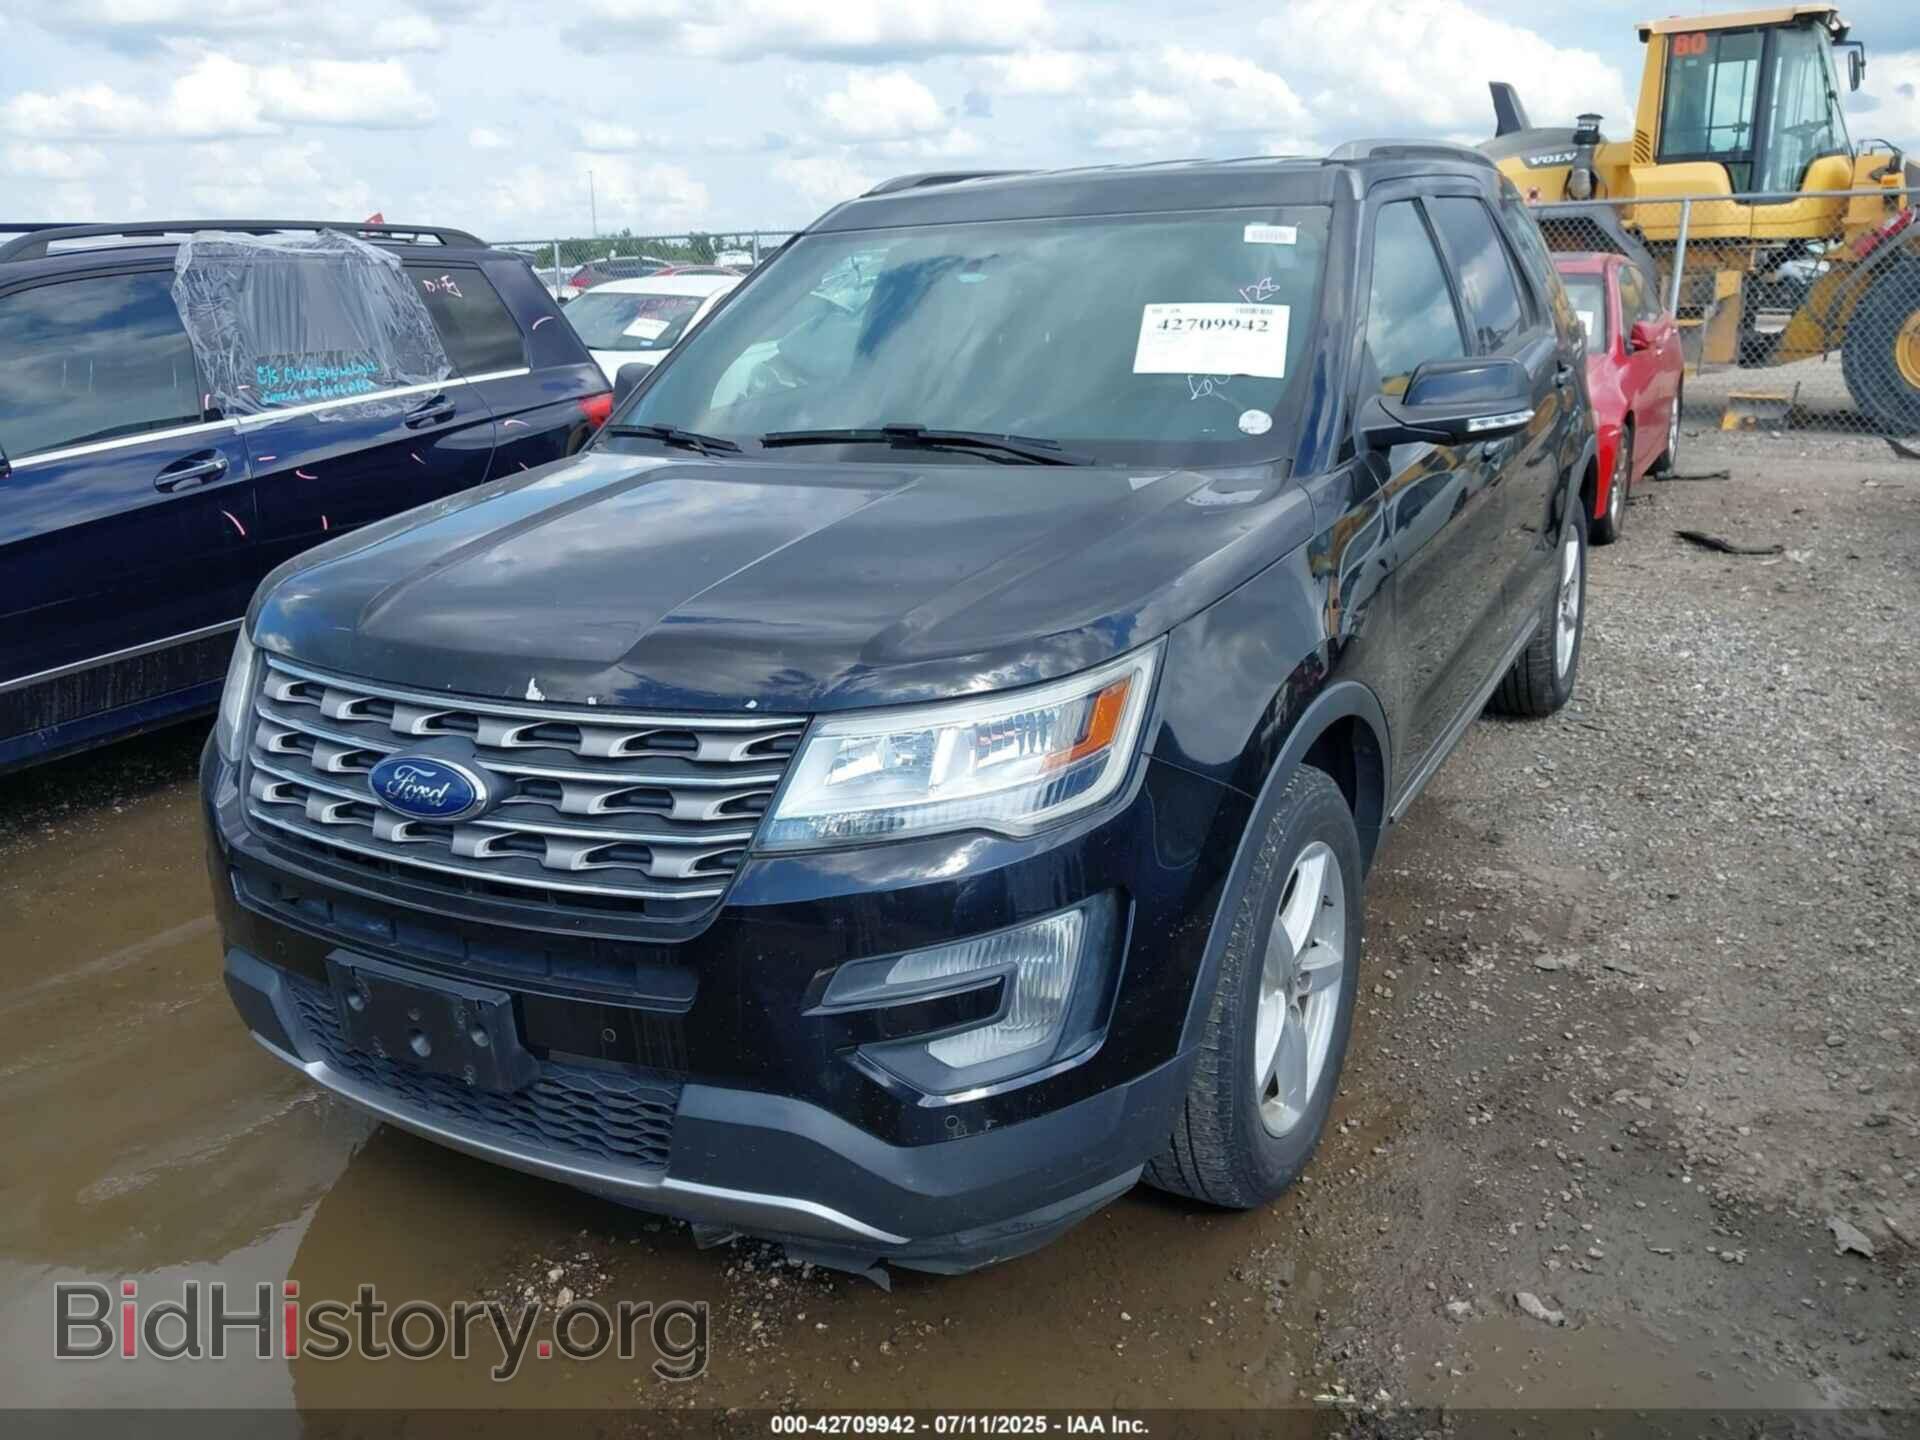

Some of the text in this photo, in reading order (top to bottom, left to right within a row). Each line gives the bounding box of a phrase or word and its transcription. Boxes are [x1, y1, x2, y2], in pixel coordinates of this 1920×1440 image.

[1530, 151, 1578, 166] VOLV
[1156, 317, 1271, 333] 42709942
[386, 764, 452, 808] Ford
